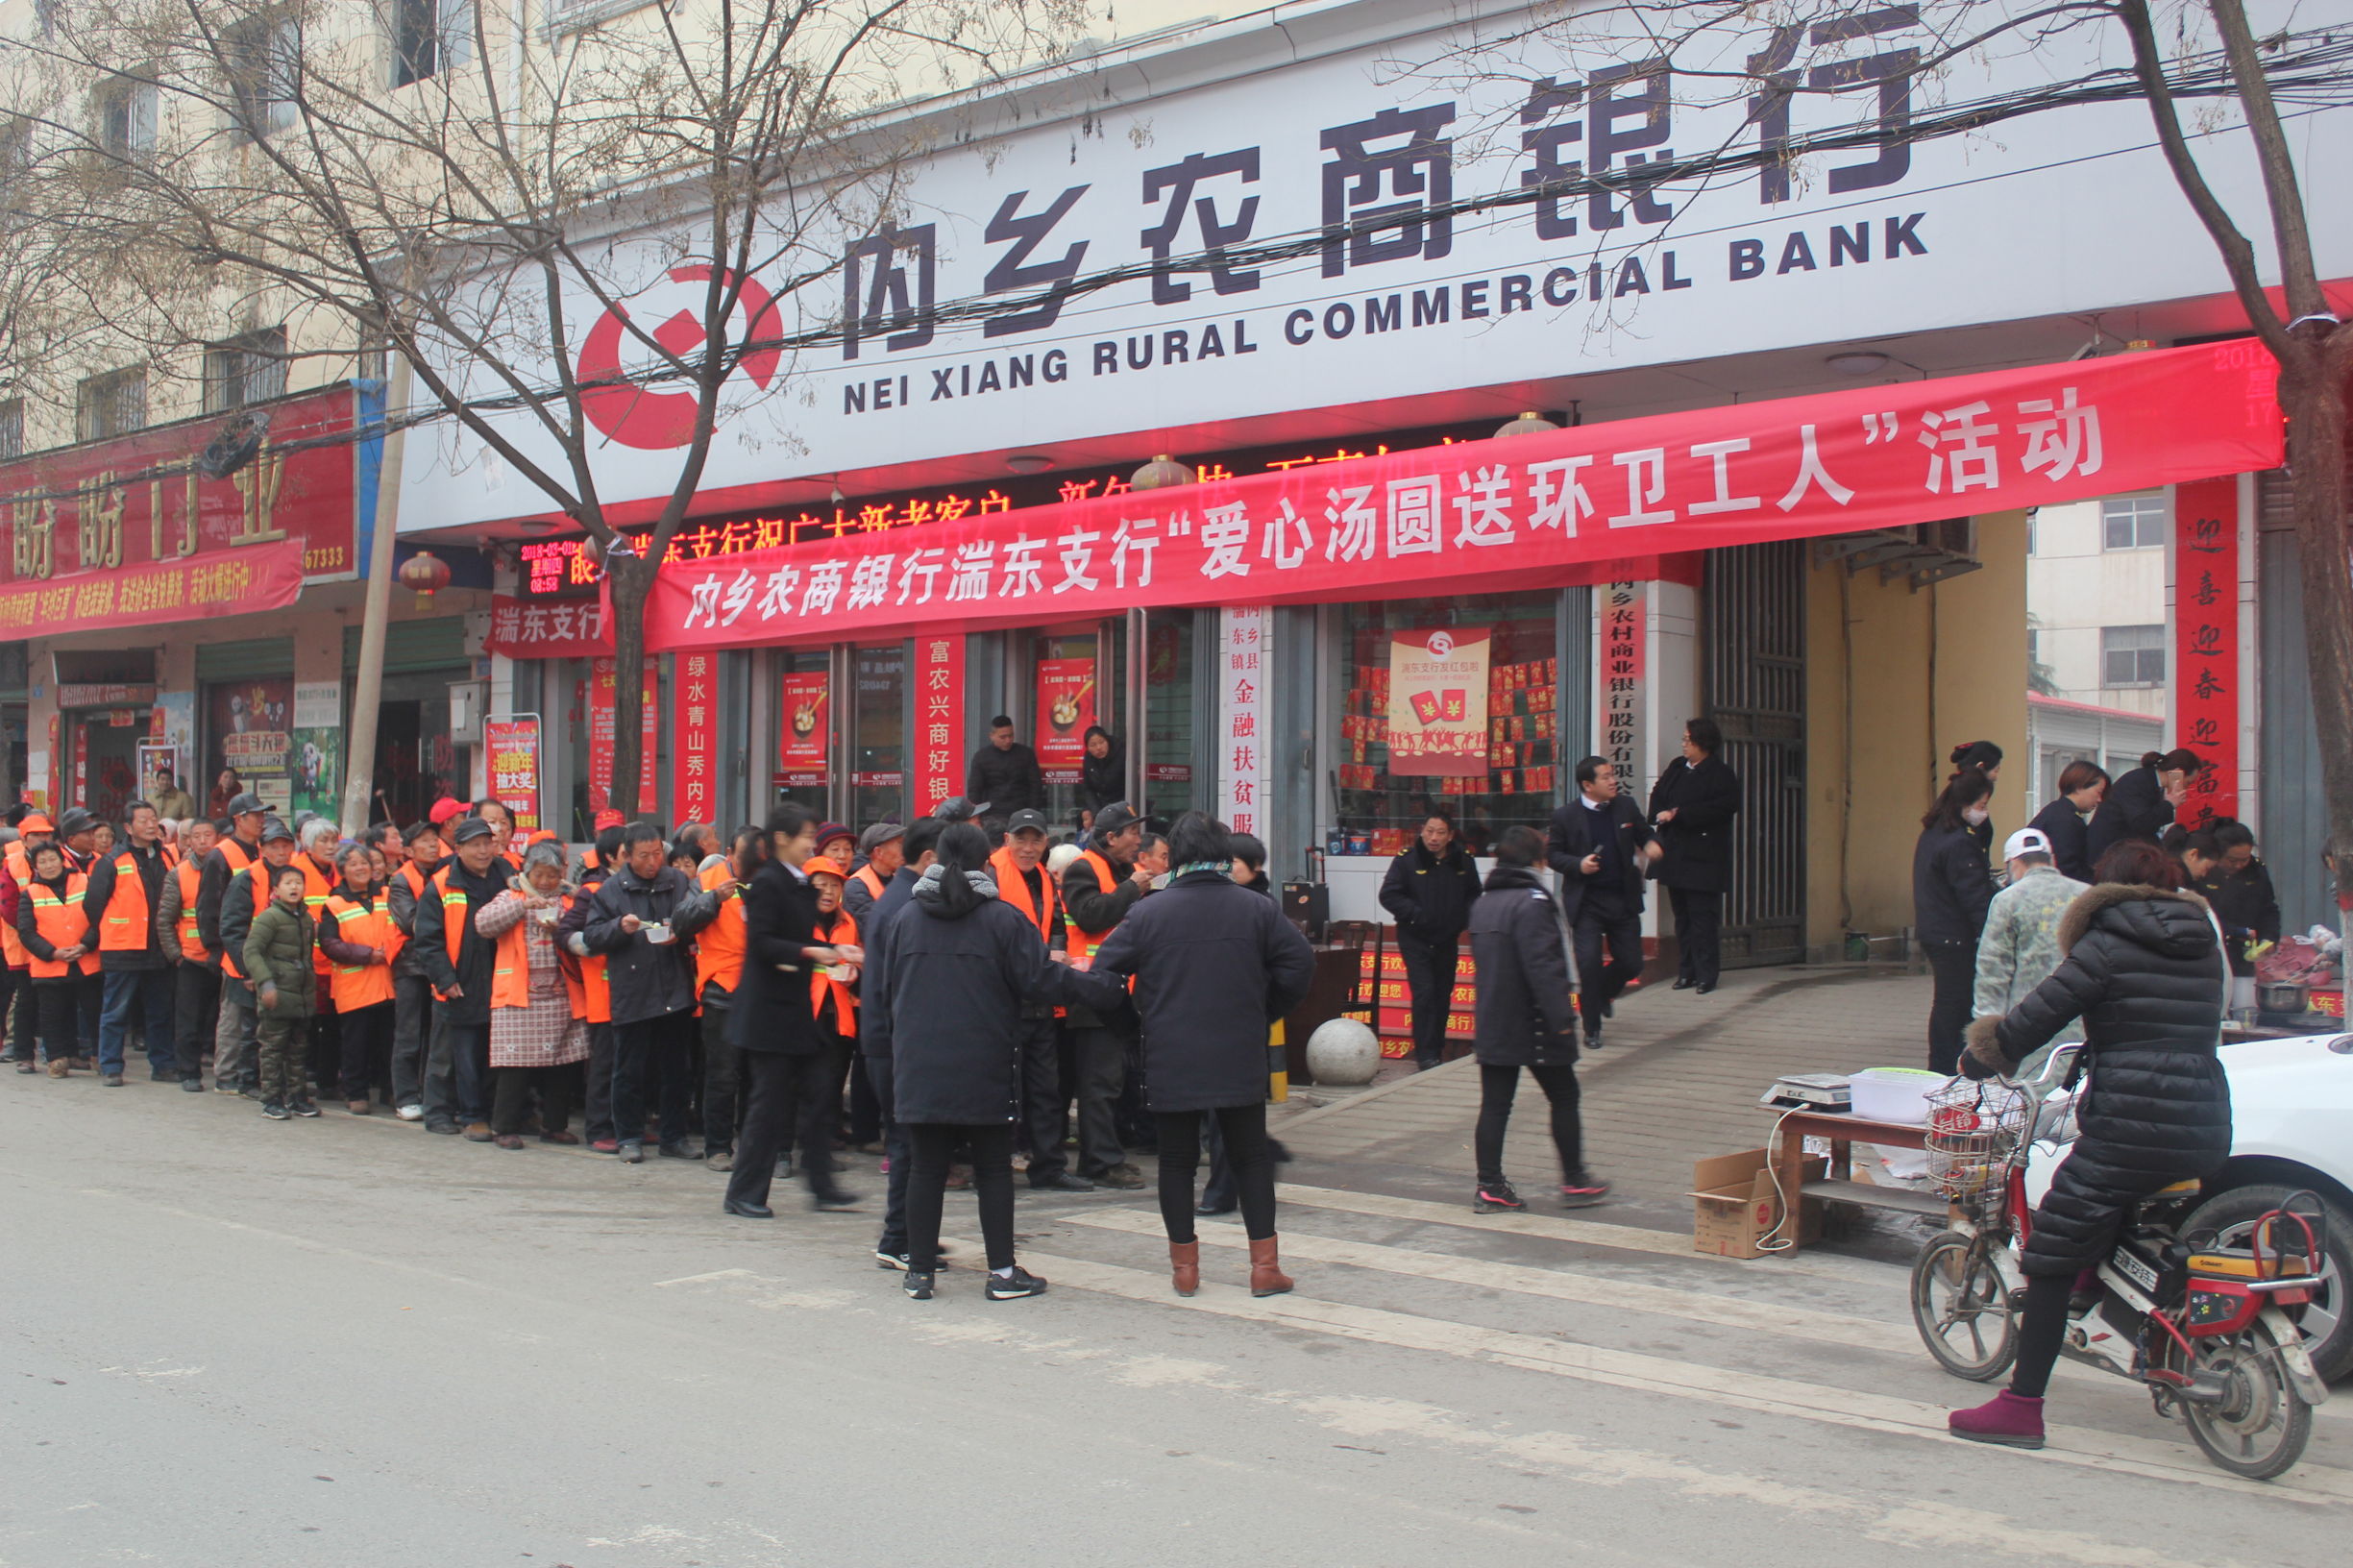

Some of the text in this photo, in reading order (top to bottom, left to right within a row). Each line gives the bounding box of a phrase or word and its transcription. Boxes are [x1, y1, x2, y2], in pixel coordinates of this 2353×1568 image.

[843, 3, 1922, 362] 内乡农商银行
[845, 212, 1929, 415] NEI XIANG RURAL COMMERCIAL BANK
[14, 436, 286, 580] 盼盼门业
[683, 386, 2103, 629] 内乡农商银行湍东支行“爱心汤圆送环卫工人”活动
[495, 603, 601, 643] 湍东支行
[496, 752, 533, 772] 迎新年
[496, 772, 537, 789] 抽大奖
[686, 656, 707, 822] 绿水青山秀内乡
[928, 640, 950, 817] 富农兴商好银
[1232, 678, 1255, 834] 金融扶贫服
